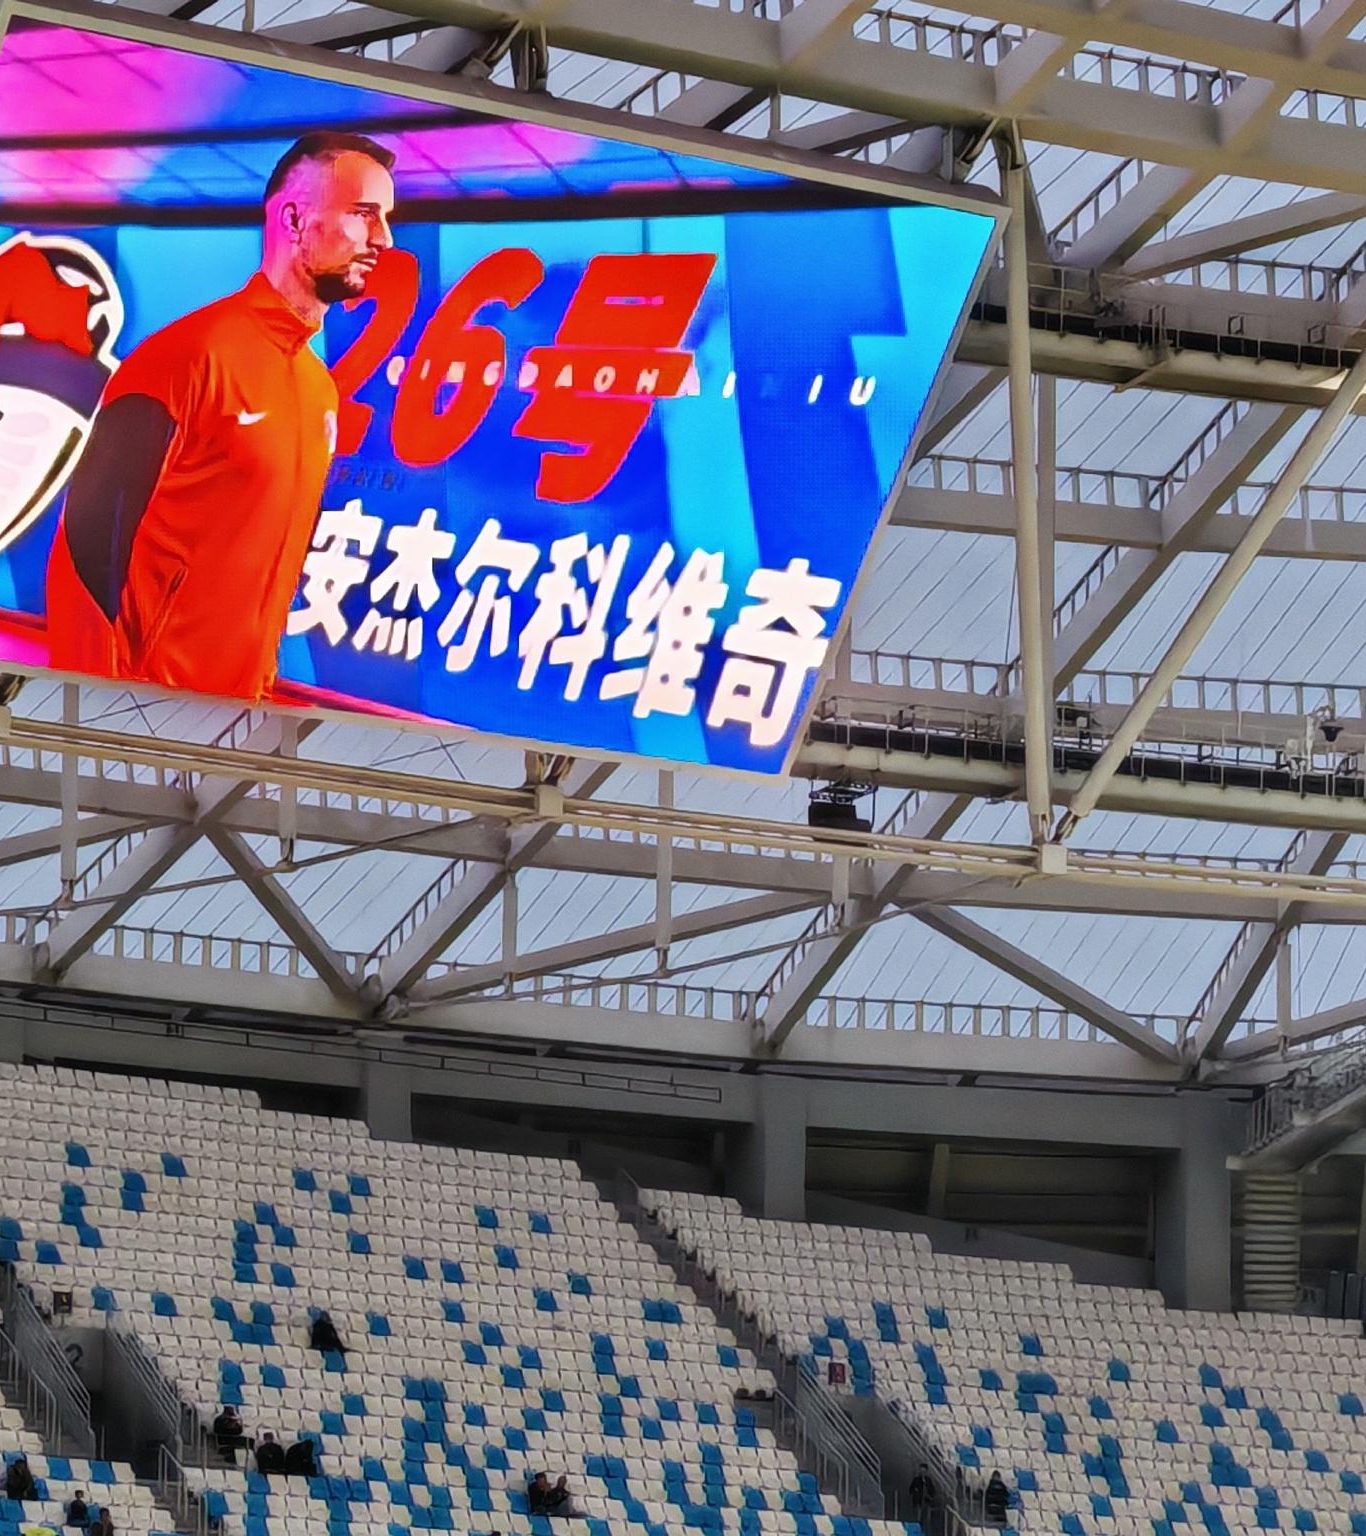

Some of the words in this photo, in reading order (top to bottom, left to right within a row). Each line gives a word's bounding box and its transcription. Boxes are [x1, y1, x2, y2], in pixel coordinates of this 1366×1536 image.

[332, 247, 720, 504] 26号
[286, 498, 842, 750] 安杰尔科维奇
